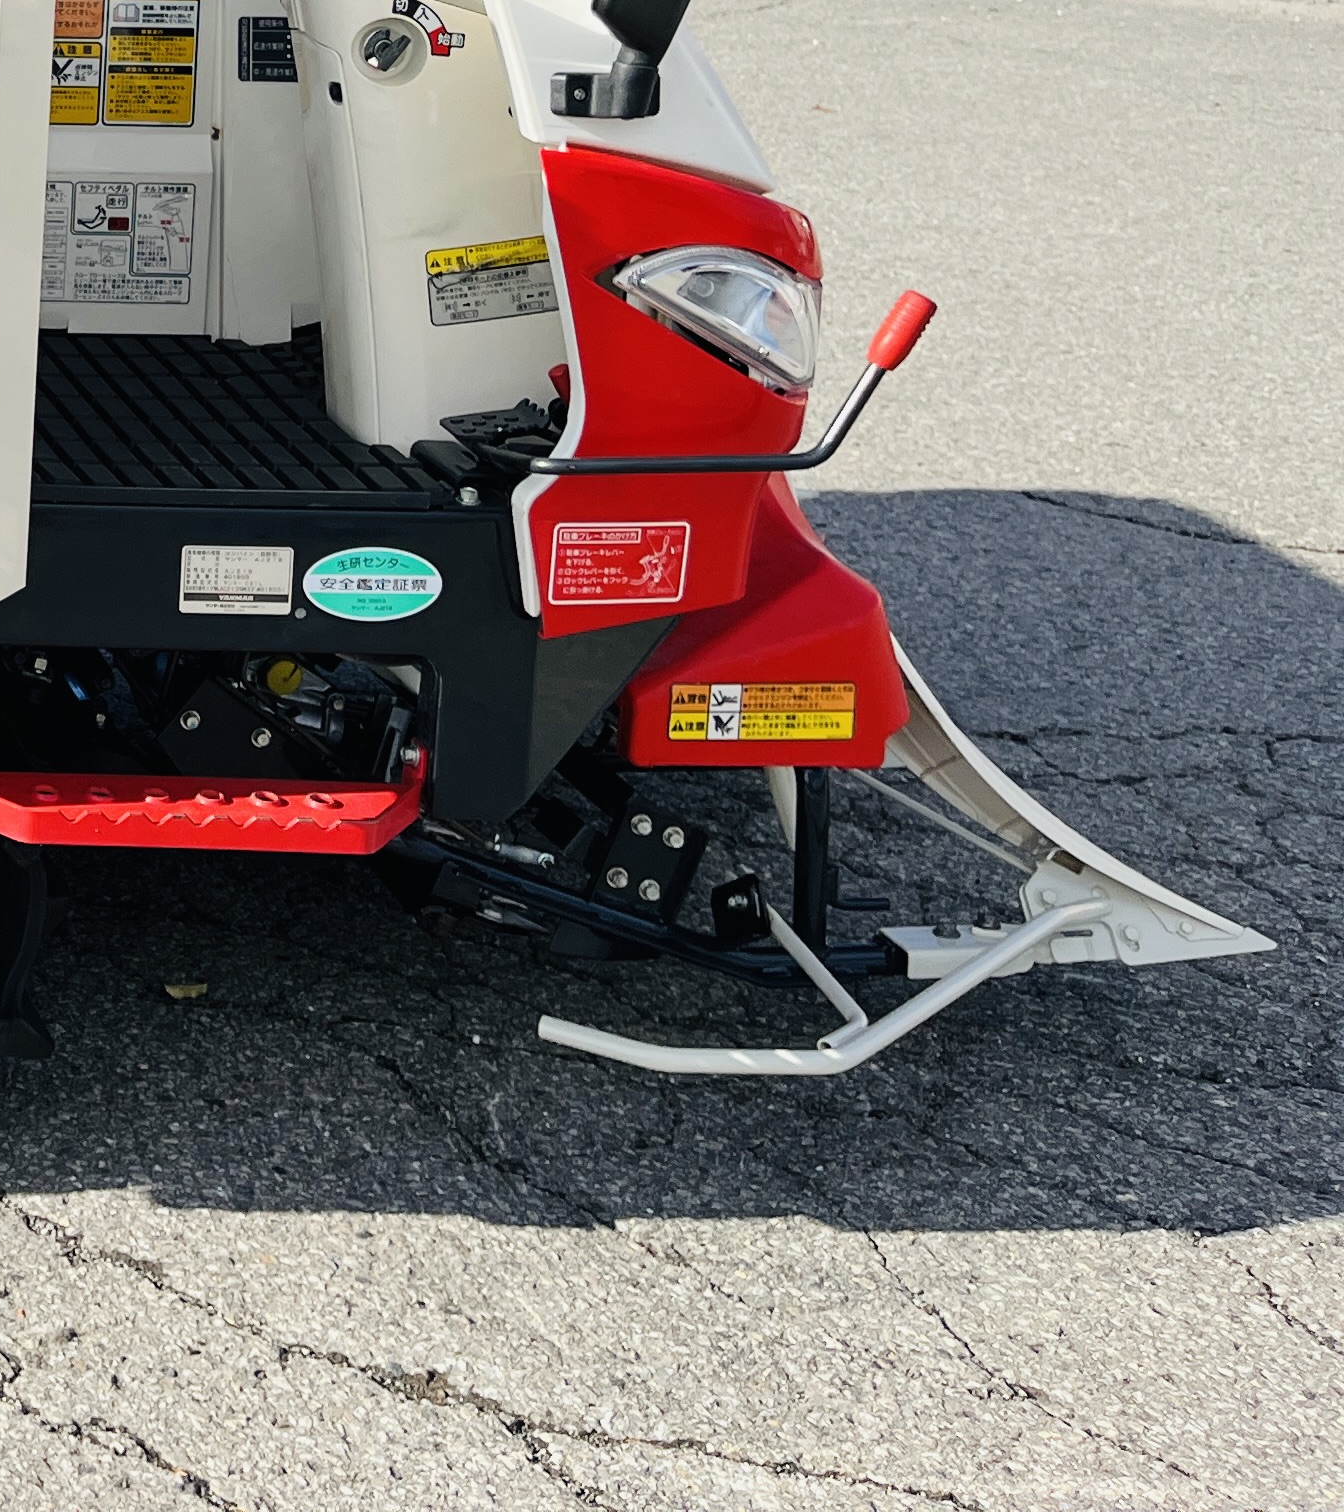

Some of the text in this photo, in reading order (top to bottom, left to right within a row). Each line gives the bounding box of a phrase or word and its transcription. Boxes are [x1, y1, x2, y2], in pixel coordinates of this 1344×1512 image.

[417, 7, 430, 20] 入
[437, 33, 464, 47] 始動
[444, 256, 465, 267] 注意
[337, 556, 410, 572] 生研センター
[320, 577, 428, 591] 安全鑑定証票
[687, 694, 707, 704] 警告
[685, 720, 705, 731] 注意
